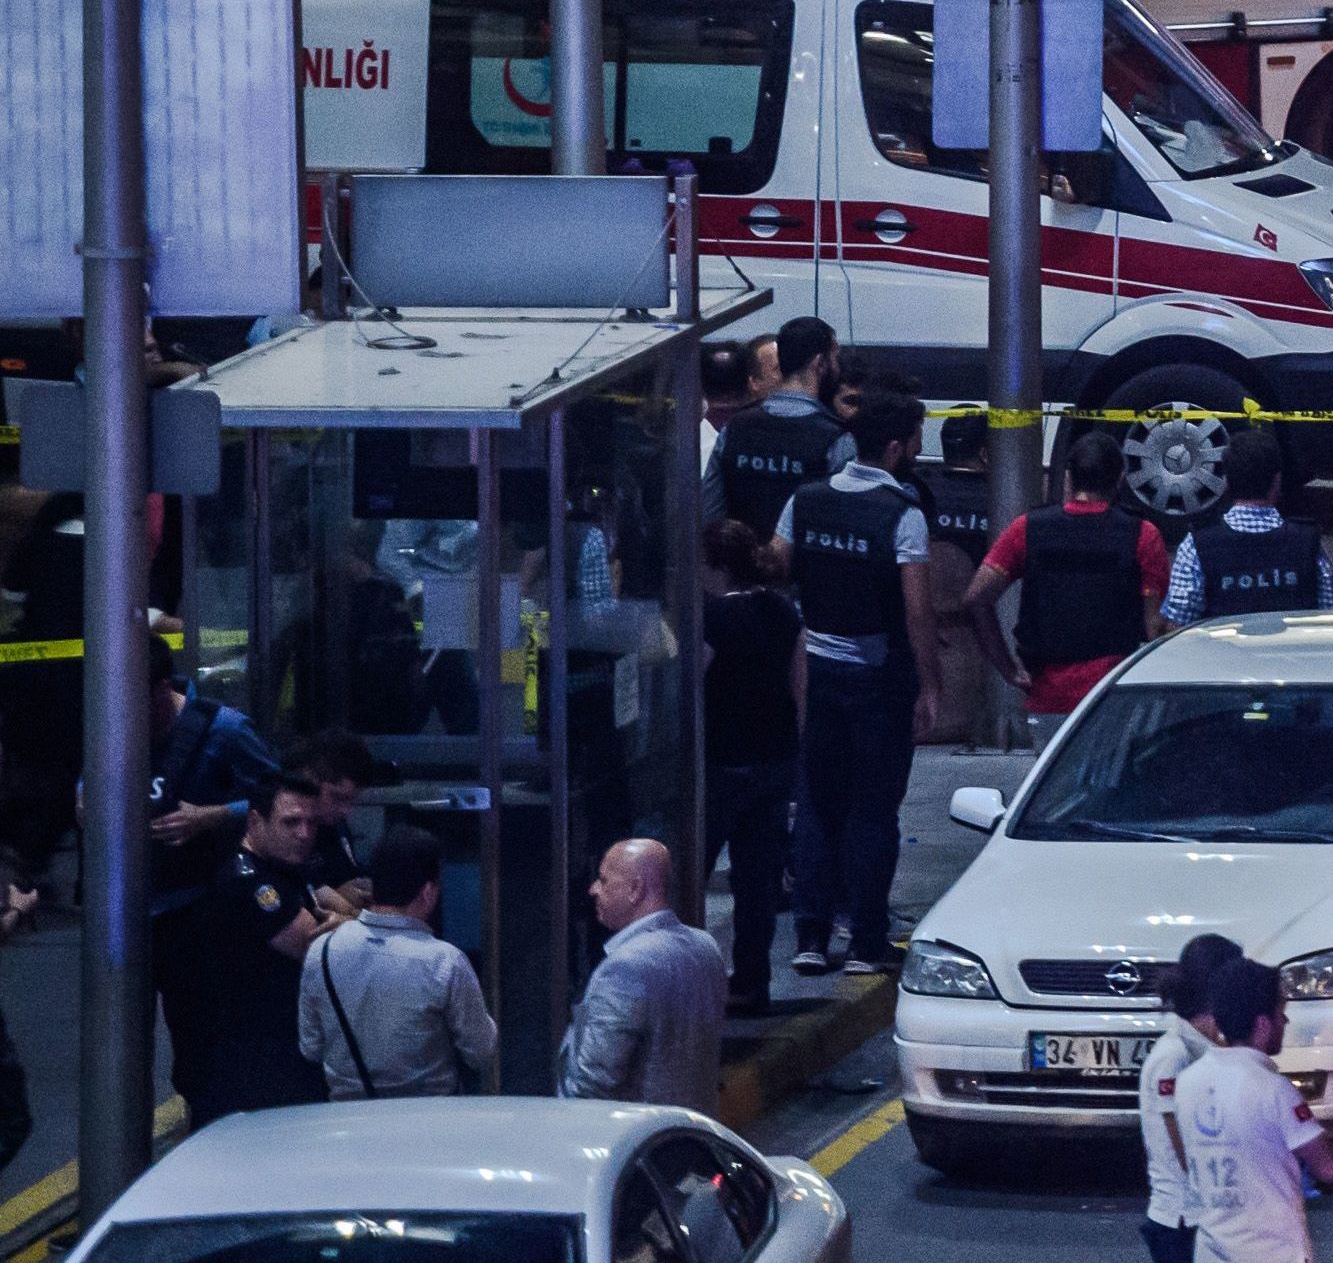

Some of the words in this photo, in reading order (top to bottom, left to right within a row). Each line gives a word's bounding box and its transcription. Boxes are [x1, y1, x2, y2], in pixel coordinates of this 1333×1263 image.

[302, 39, 390, 90] NLIĞI
[736, 454, 804, 474] POLİS
[937, 513, 989, 531] OLİS
[804, 529, 869, 553] POLİS
[1221, 568, 1298, 590] POLİS
[1047, 1039, 1077, 1066] 34
[1091, 1039, 1121, 1066] VN
[1131, 1039, 1156, 1065] 4
